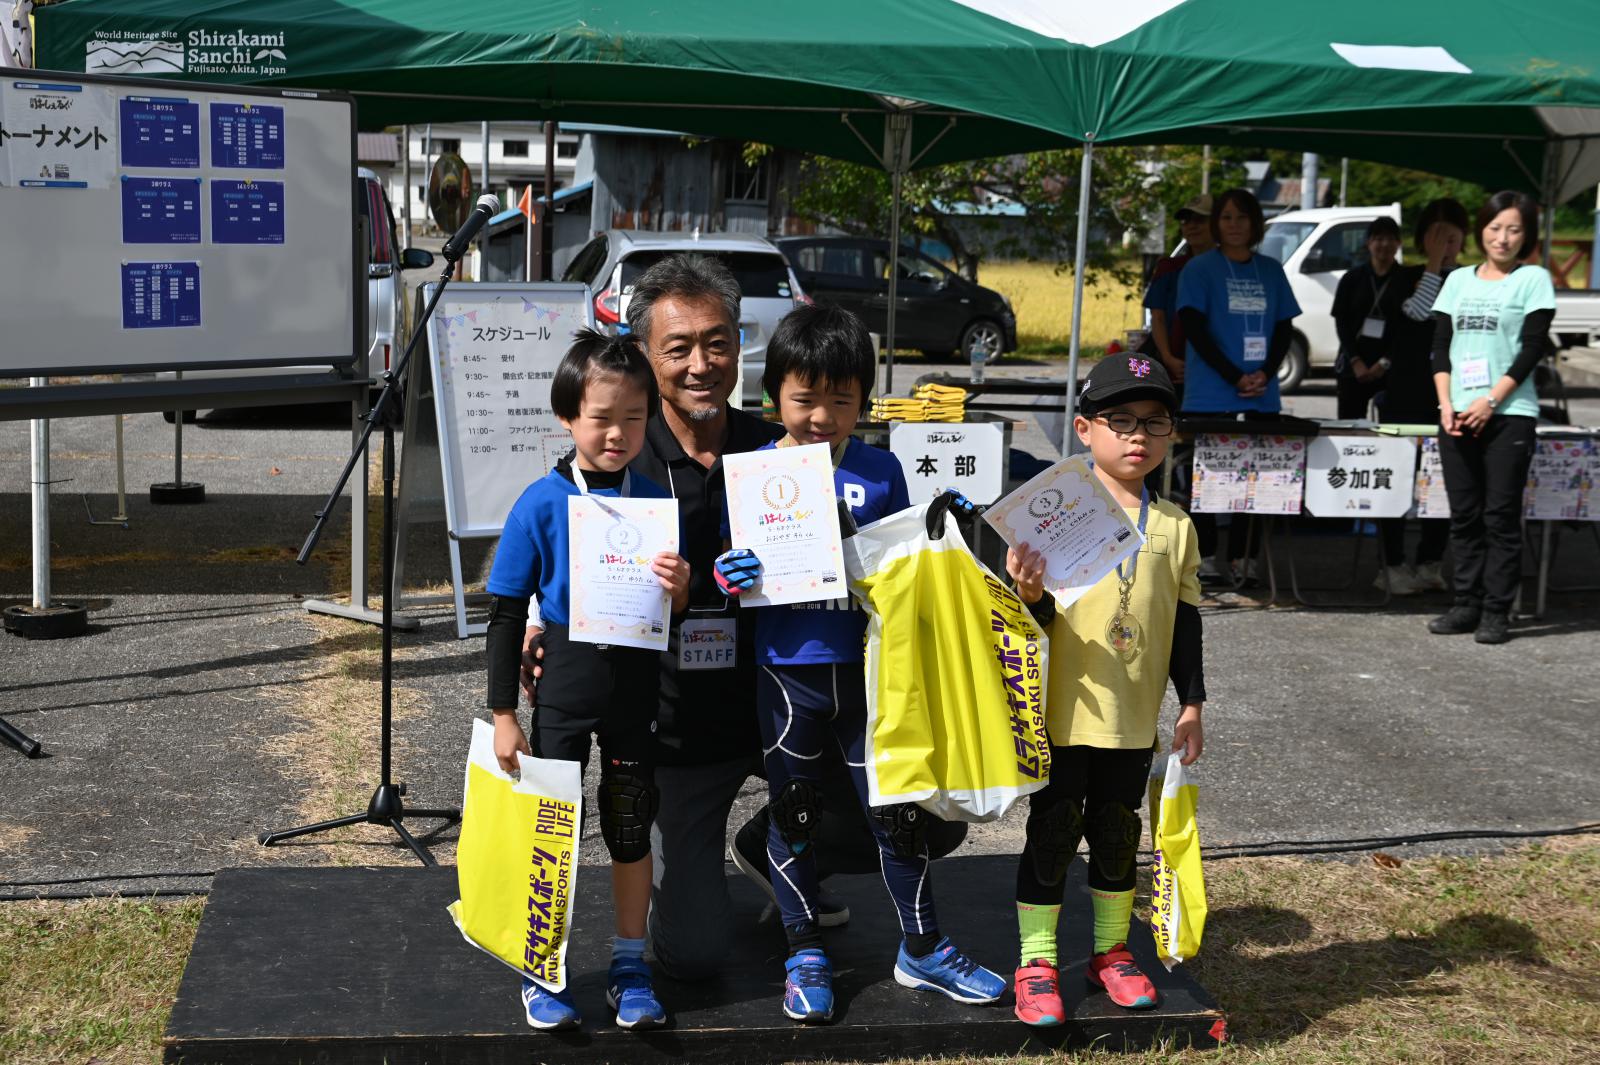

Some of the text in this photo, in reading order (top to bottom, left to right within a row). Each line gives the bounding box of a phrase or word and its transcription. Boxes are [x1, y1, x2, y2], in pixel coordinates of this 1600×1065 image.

[95, 31, 122, 39] World
[123, 31, 160, 40] Heritage
[188, 29, 285, 47] Shirakami
[188, 48, 252, 64] Sanchi
[188, 64, 286, 76] Fujisato, Akita, Japan
[0, 122, 108, 151] トーナメント
[472, 326, 551, 342] スケジュール
[508, 426, 540, 434] ファイナル
[916, 454, 976, 477] 本部
[1327, 466, 1393, 490] 参加賞
[1040, 497, 1052, 509] 3
[619, 530, 629, 545] 2
[683, 649, 733, 663] STAFF
[535, 798, 558, 836] RIDE
[555, 802, 575, 838] LIFE
[523, 846, 558, 981] ムラサキスポーツ
[547, 849, 571, 984] MURASAKI SPORTS
